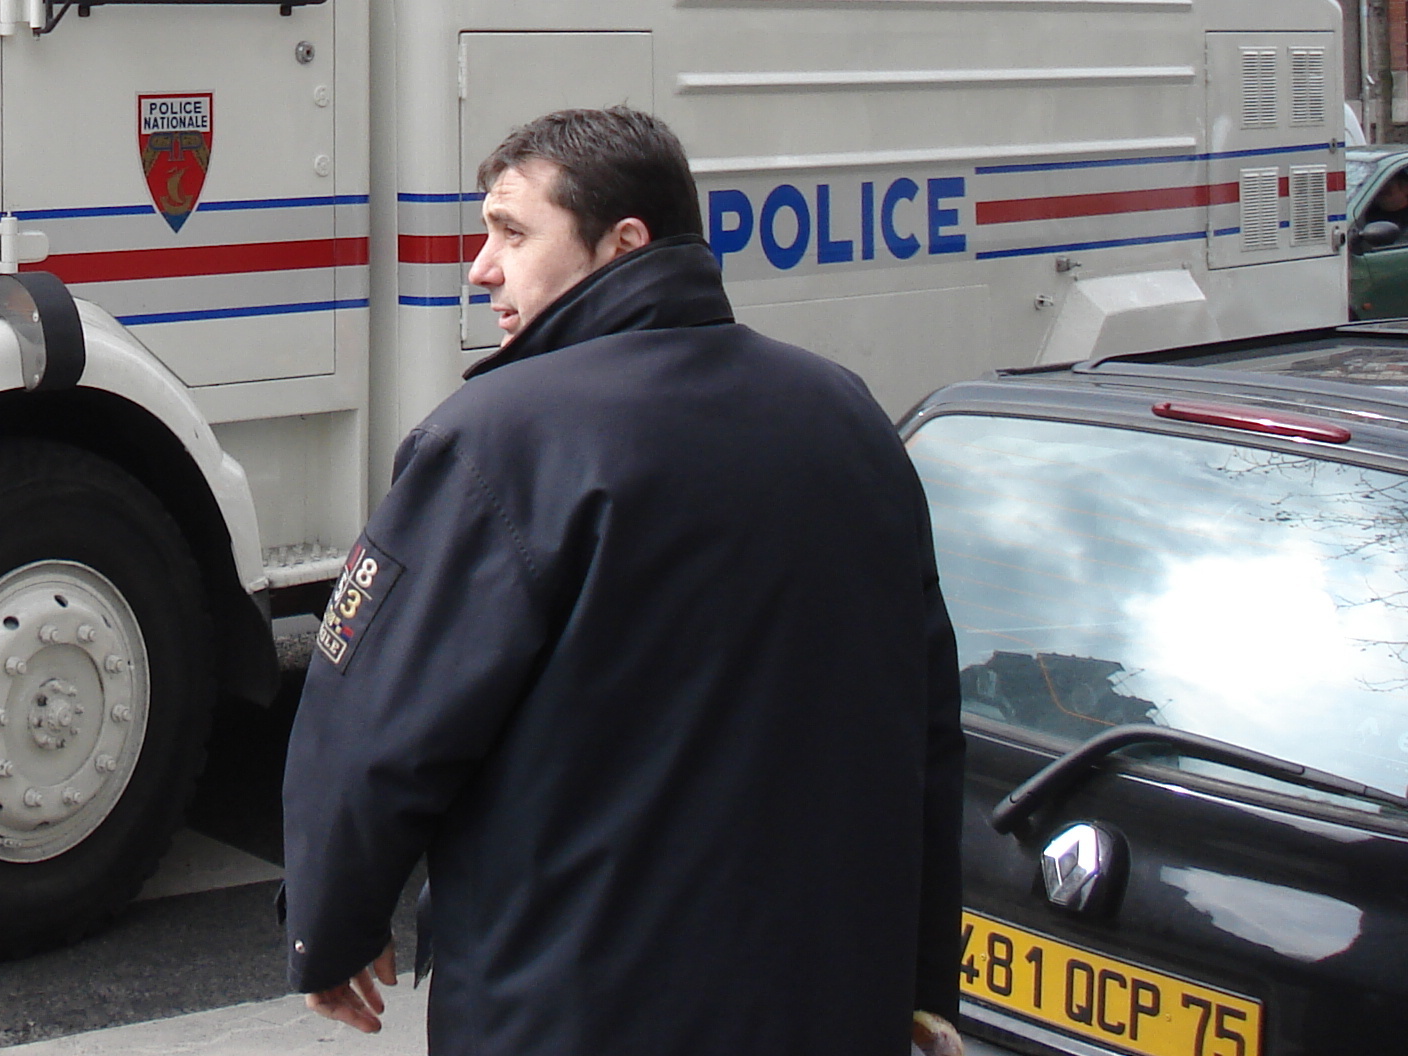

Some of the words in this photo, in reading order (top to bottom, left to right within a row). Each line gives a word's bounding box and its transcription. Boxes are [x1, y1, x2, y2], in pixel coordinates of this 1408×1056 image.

[143, 115, 208, 131] NATIONALE
[149, 101, 203, 115] POLICE
[708, 177, 967, 270] POLICE
[1064, 958, 1162, 1041] QCP
[1181, 992, 1247, 1056] 75
